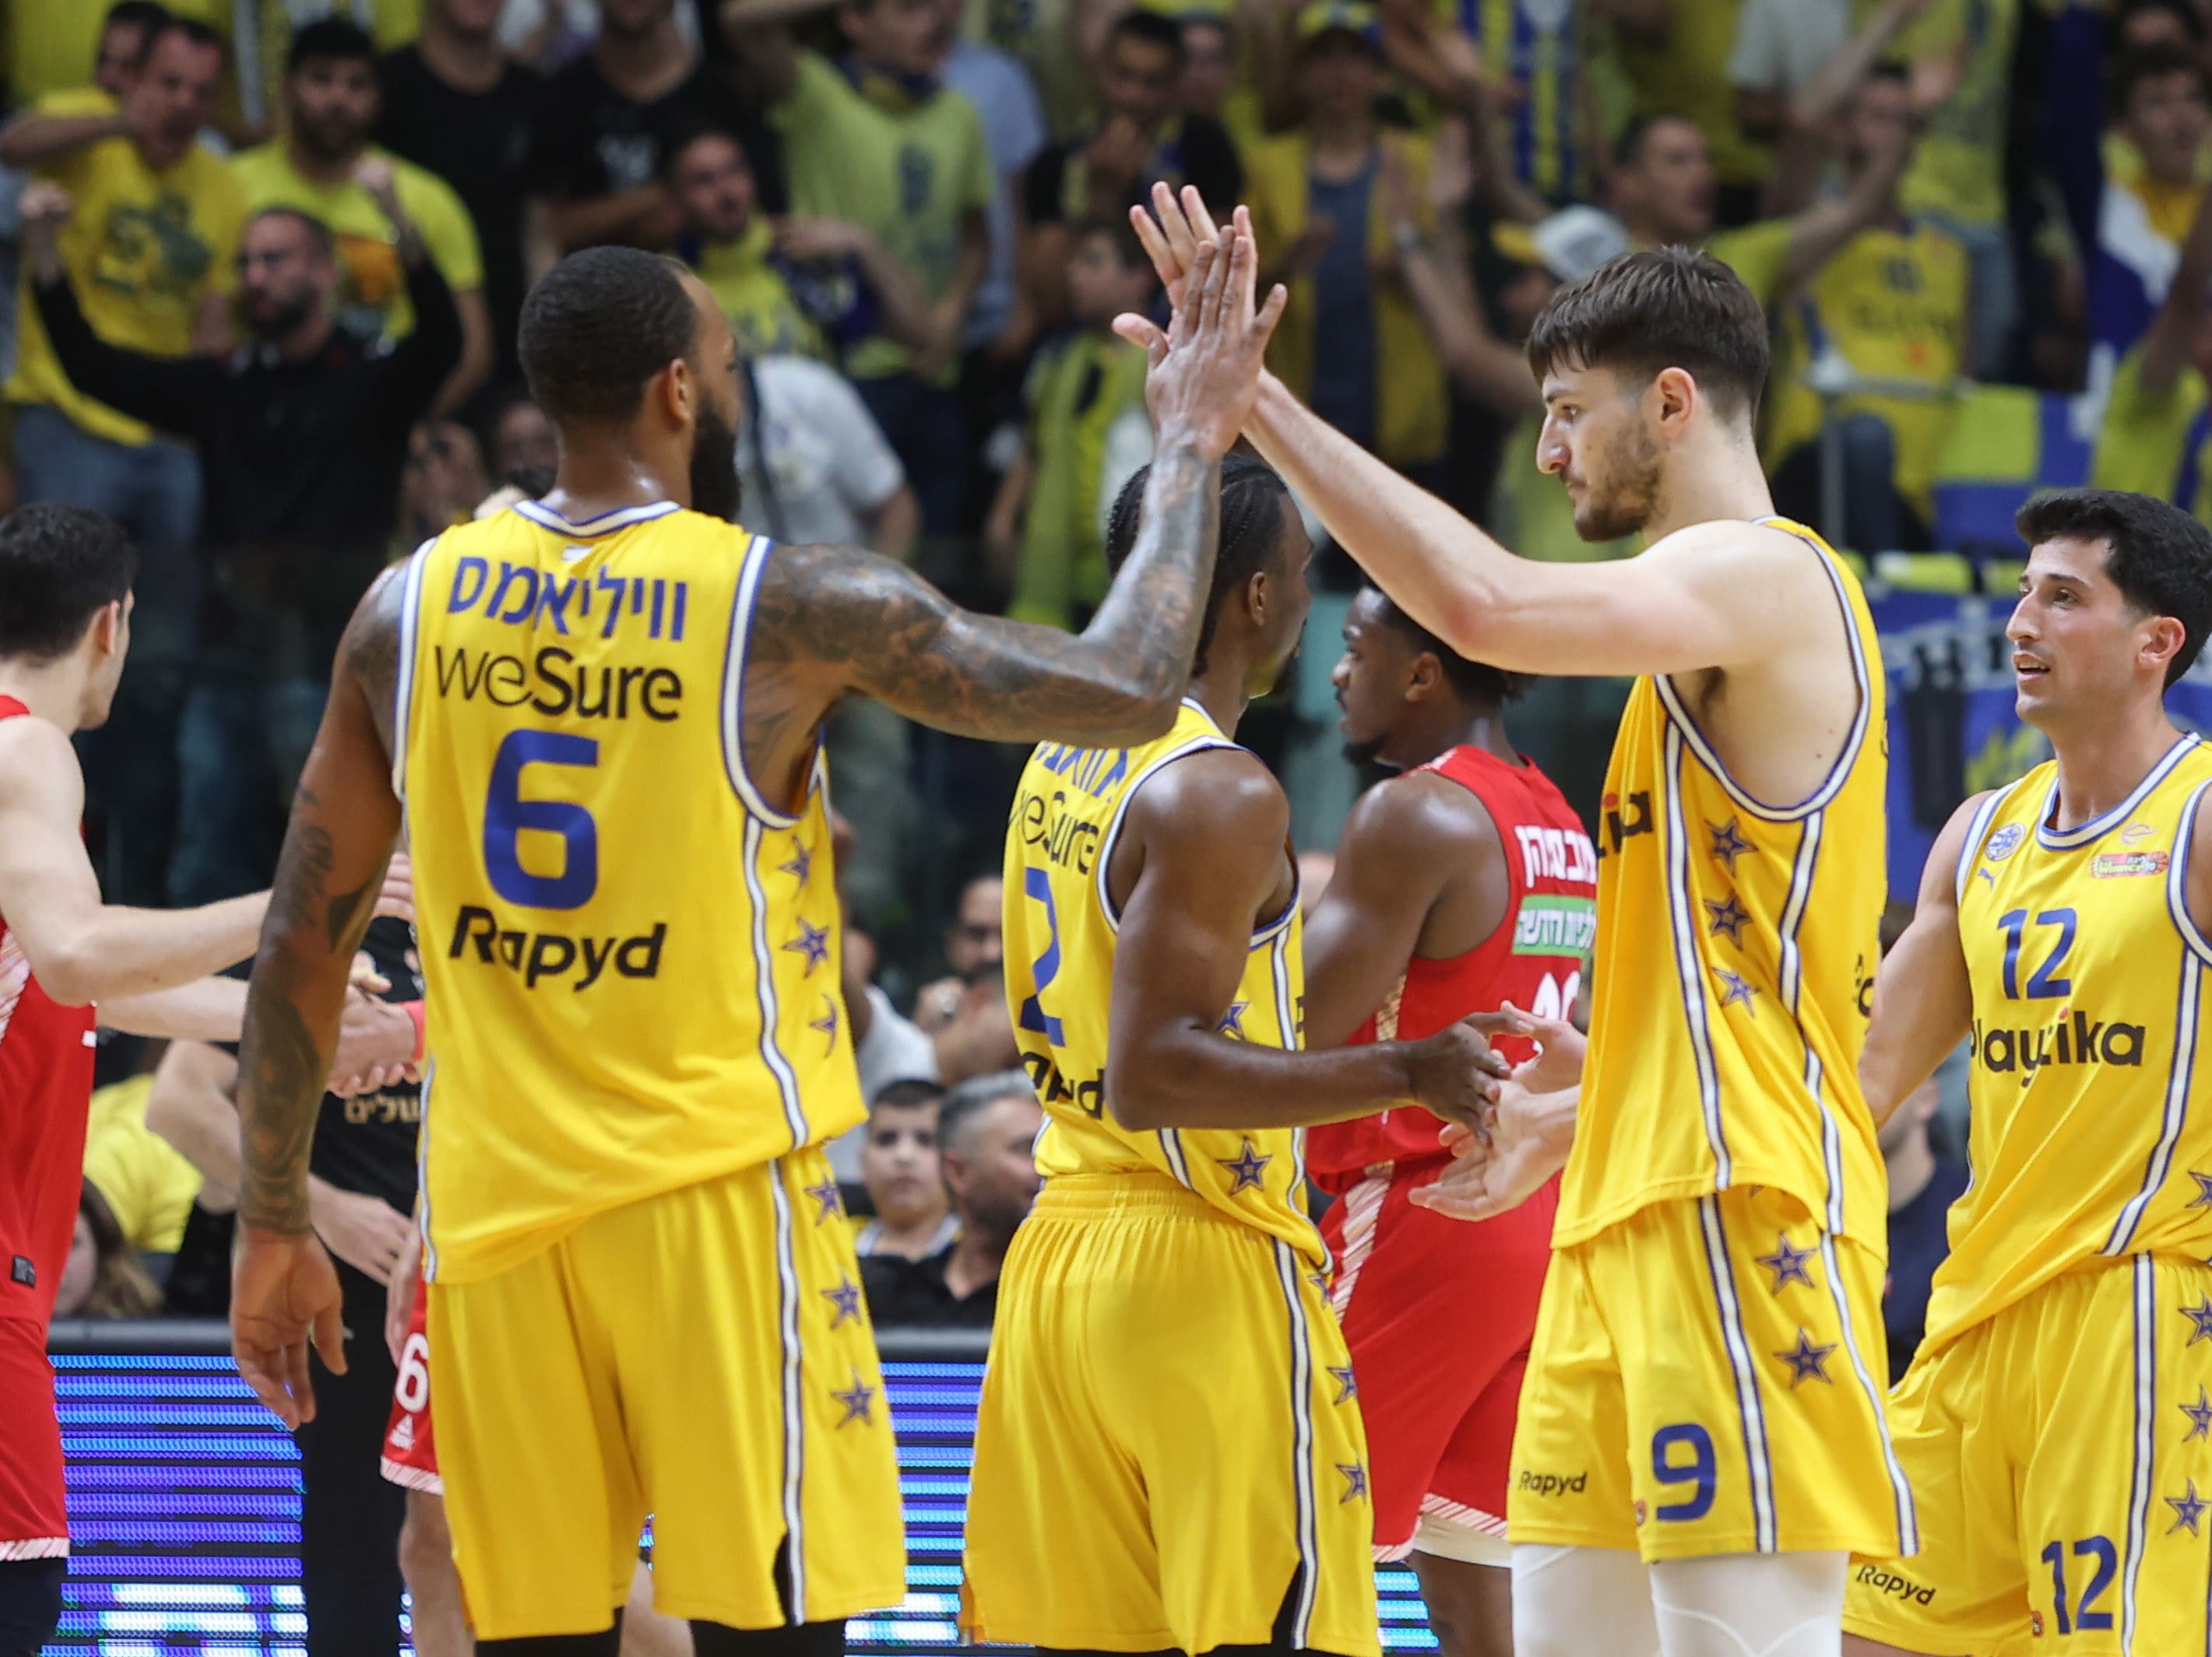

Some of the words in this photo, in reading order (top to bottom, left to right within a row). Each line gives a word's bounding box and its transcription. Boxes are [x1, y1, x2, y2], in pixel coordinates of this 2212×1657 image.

[483, 729, 597, 910] 6
[449, 904, 667, 993] Rapyd
[1020, 866, 1065, 1047] 2
[1997, 907, 2077, 1000] 12
[395, 1332, 430, 1413] 6
[1518, 1470, 1588, 1497] Rapyd
[1651, 1421, 1716, 1522] 9
[1855, 1564, 1936, 1607] Rapyd
[2041, 1534, 2118, 1635] 12
